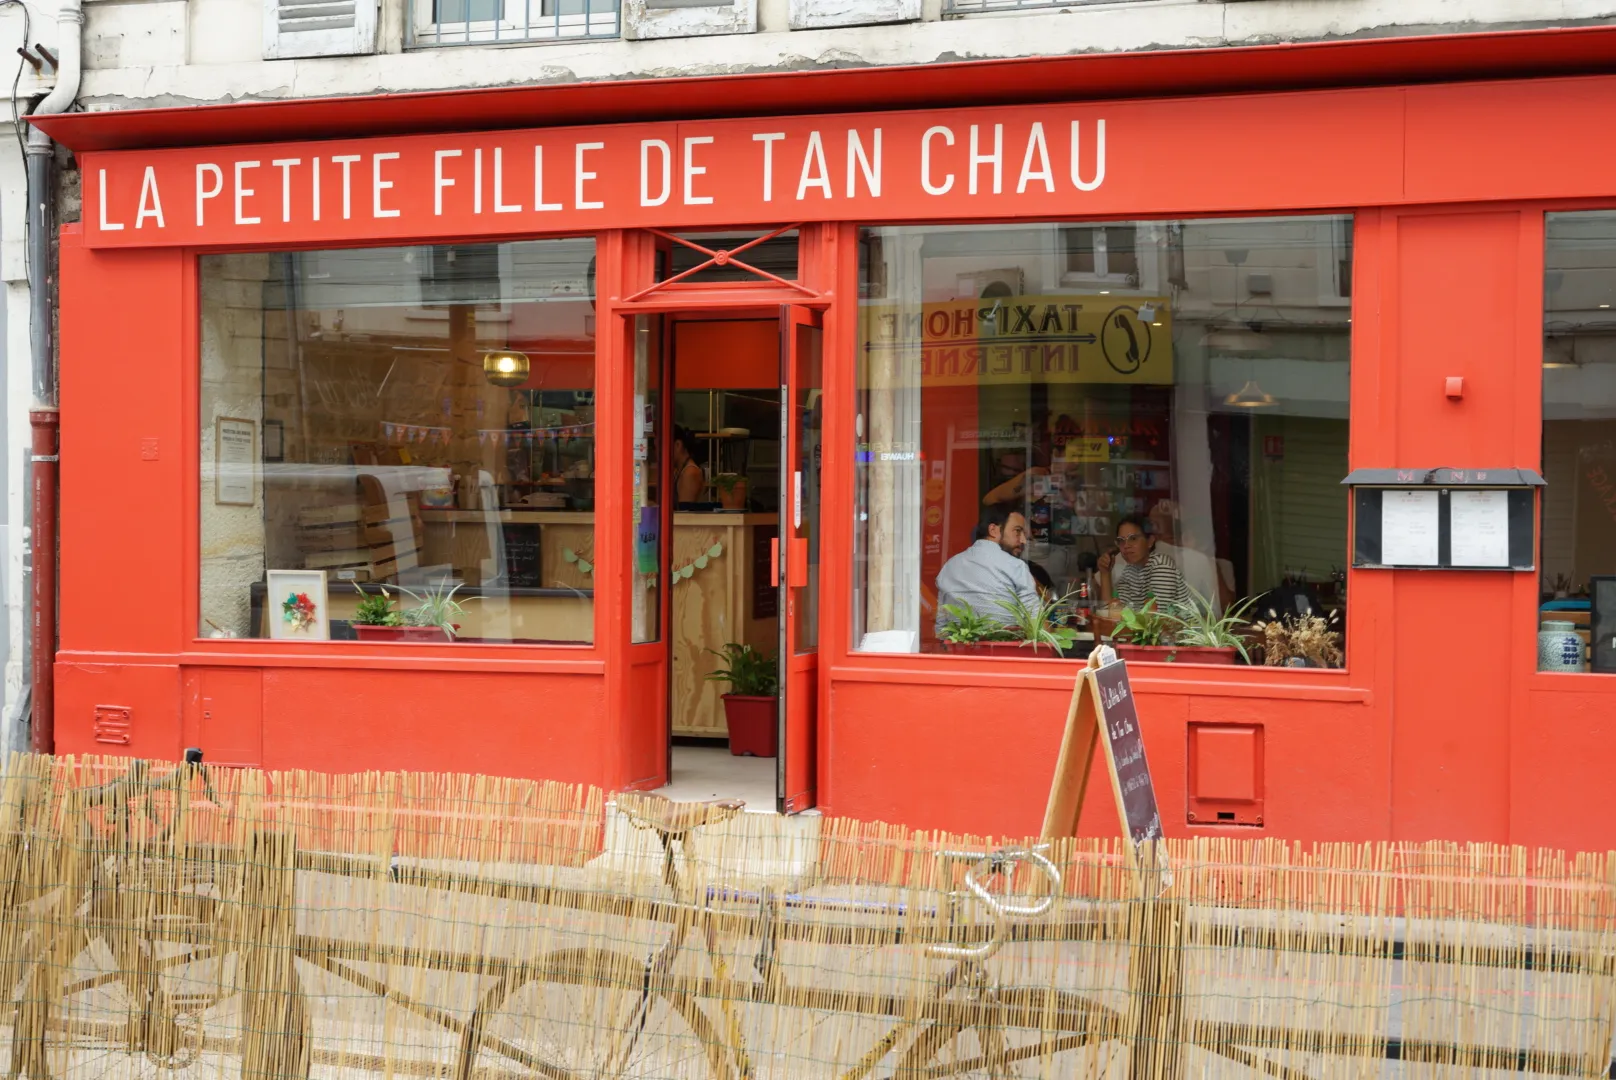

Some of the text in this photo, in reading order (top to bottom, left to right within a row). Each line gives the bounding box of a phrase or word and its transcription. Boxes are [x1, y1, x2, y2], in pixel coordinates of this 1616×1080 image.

[99, 120, 1106, 231] LA PETITE FILLE DE TAN CHAU
